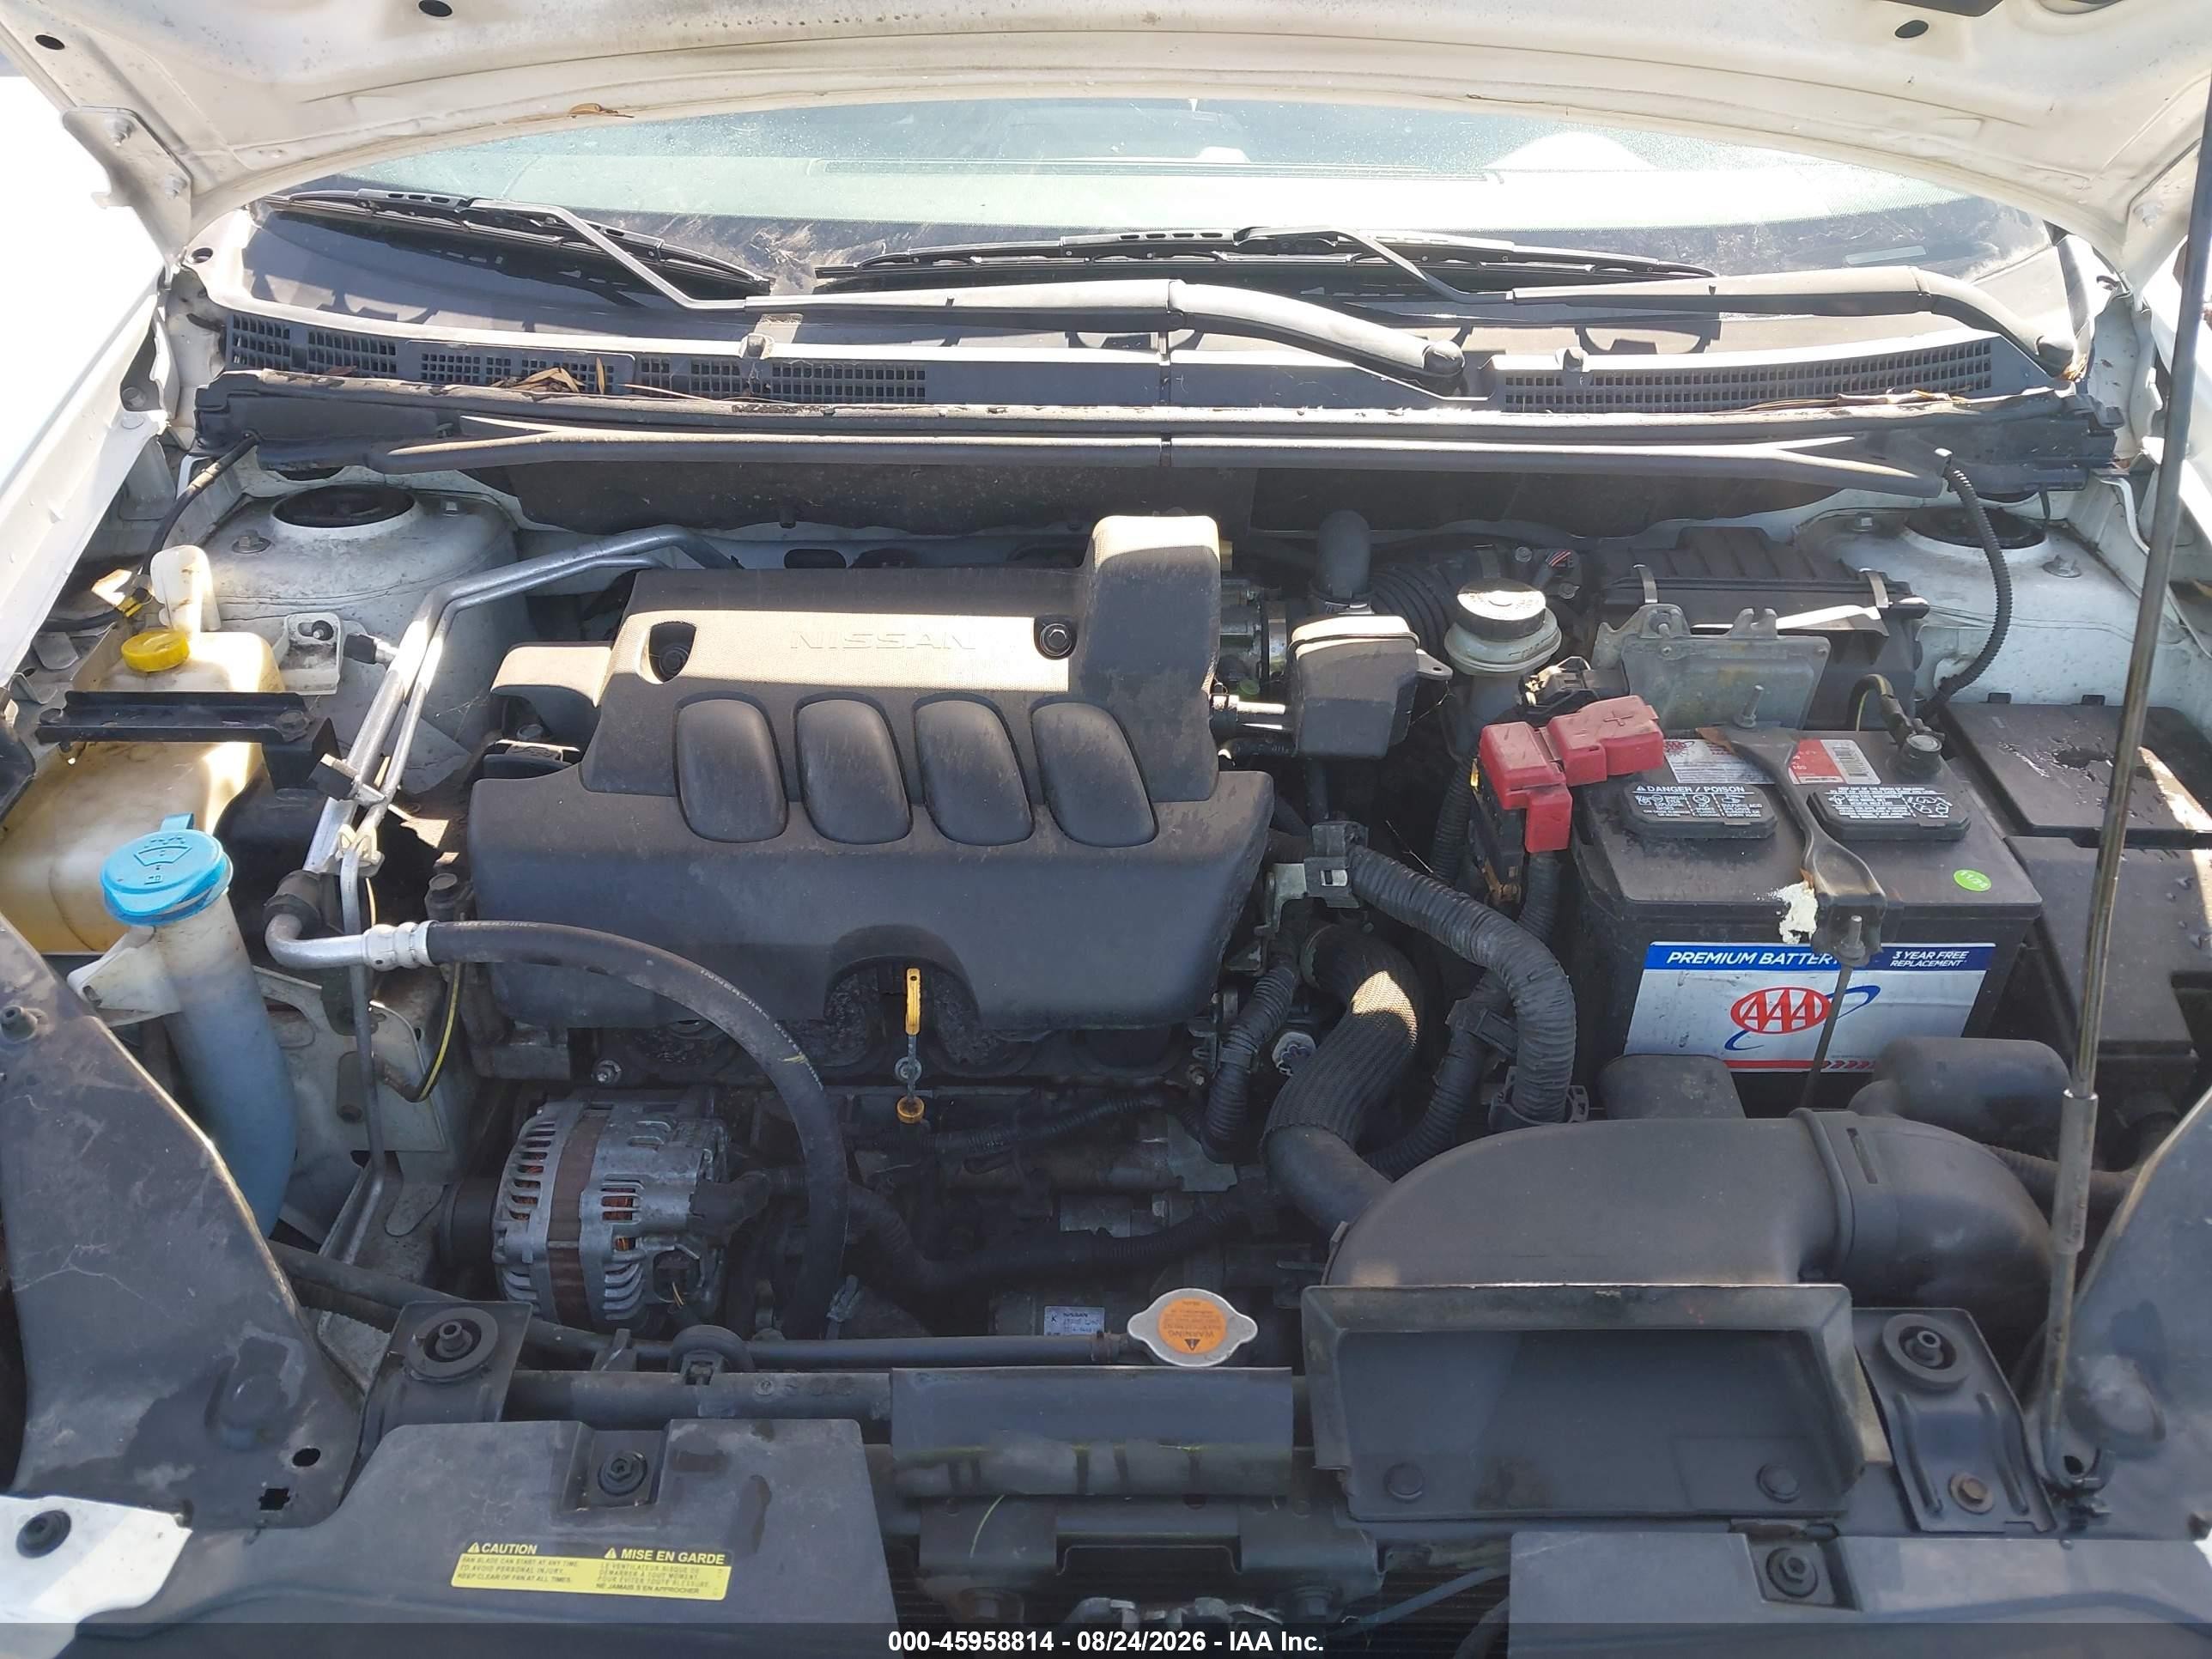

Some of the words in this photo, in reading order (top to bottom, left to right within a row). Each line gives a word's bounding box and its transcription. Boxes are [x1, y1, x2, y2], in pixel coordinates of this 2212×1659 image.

[789, 631, 976, 650] NISSAN
[1666, 951, 1761, 965] PREMIUM
[1758, 952, 1838, 964] BATTER
[1892, 951, 1903, 959] 3
[1903, 951, 1936, 960] YEAR
[1936, 951, 1970, 959] FREE
[1735, 988, 1830, 1033] AAA
[481, 1543, 538, 1555] CAUTION
[621, 1549, 653, 1561] MISE
[656, 1551, 675, 1562] EN
[678, 1553, 726, 1565] GARDE
